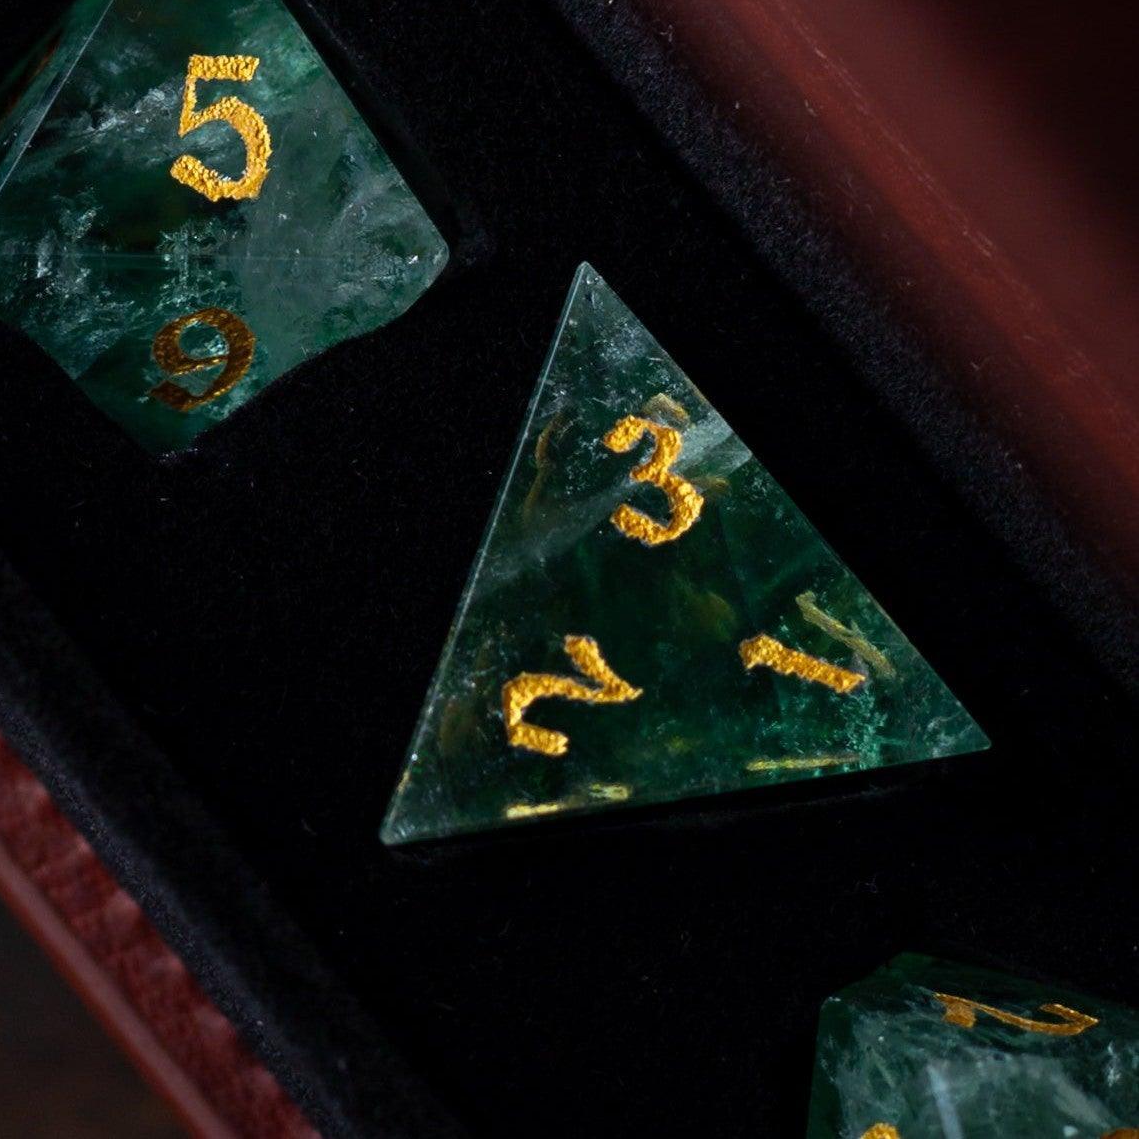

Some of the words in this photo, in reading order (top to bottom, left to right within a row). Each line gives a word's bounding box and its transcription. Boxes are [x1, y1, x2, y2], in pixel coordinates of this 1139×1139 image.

[170, 54, 272, 202] 5
[603, 414, 704, 547] 3
[502, 635, 643, 756] 2
